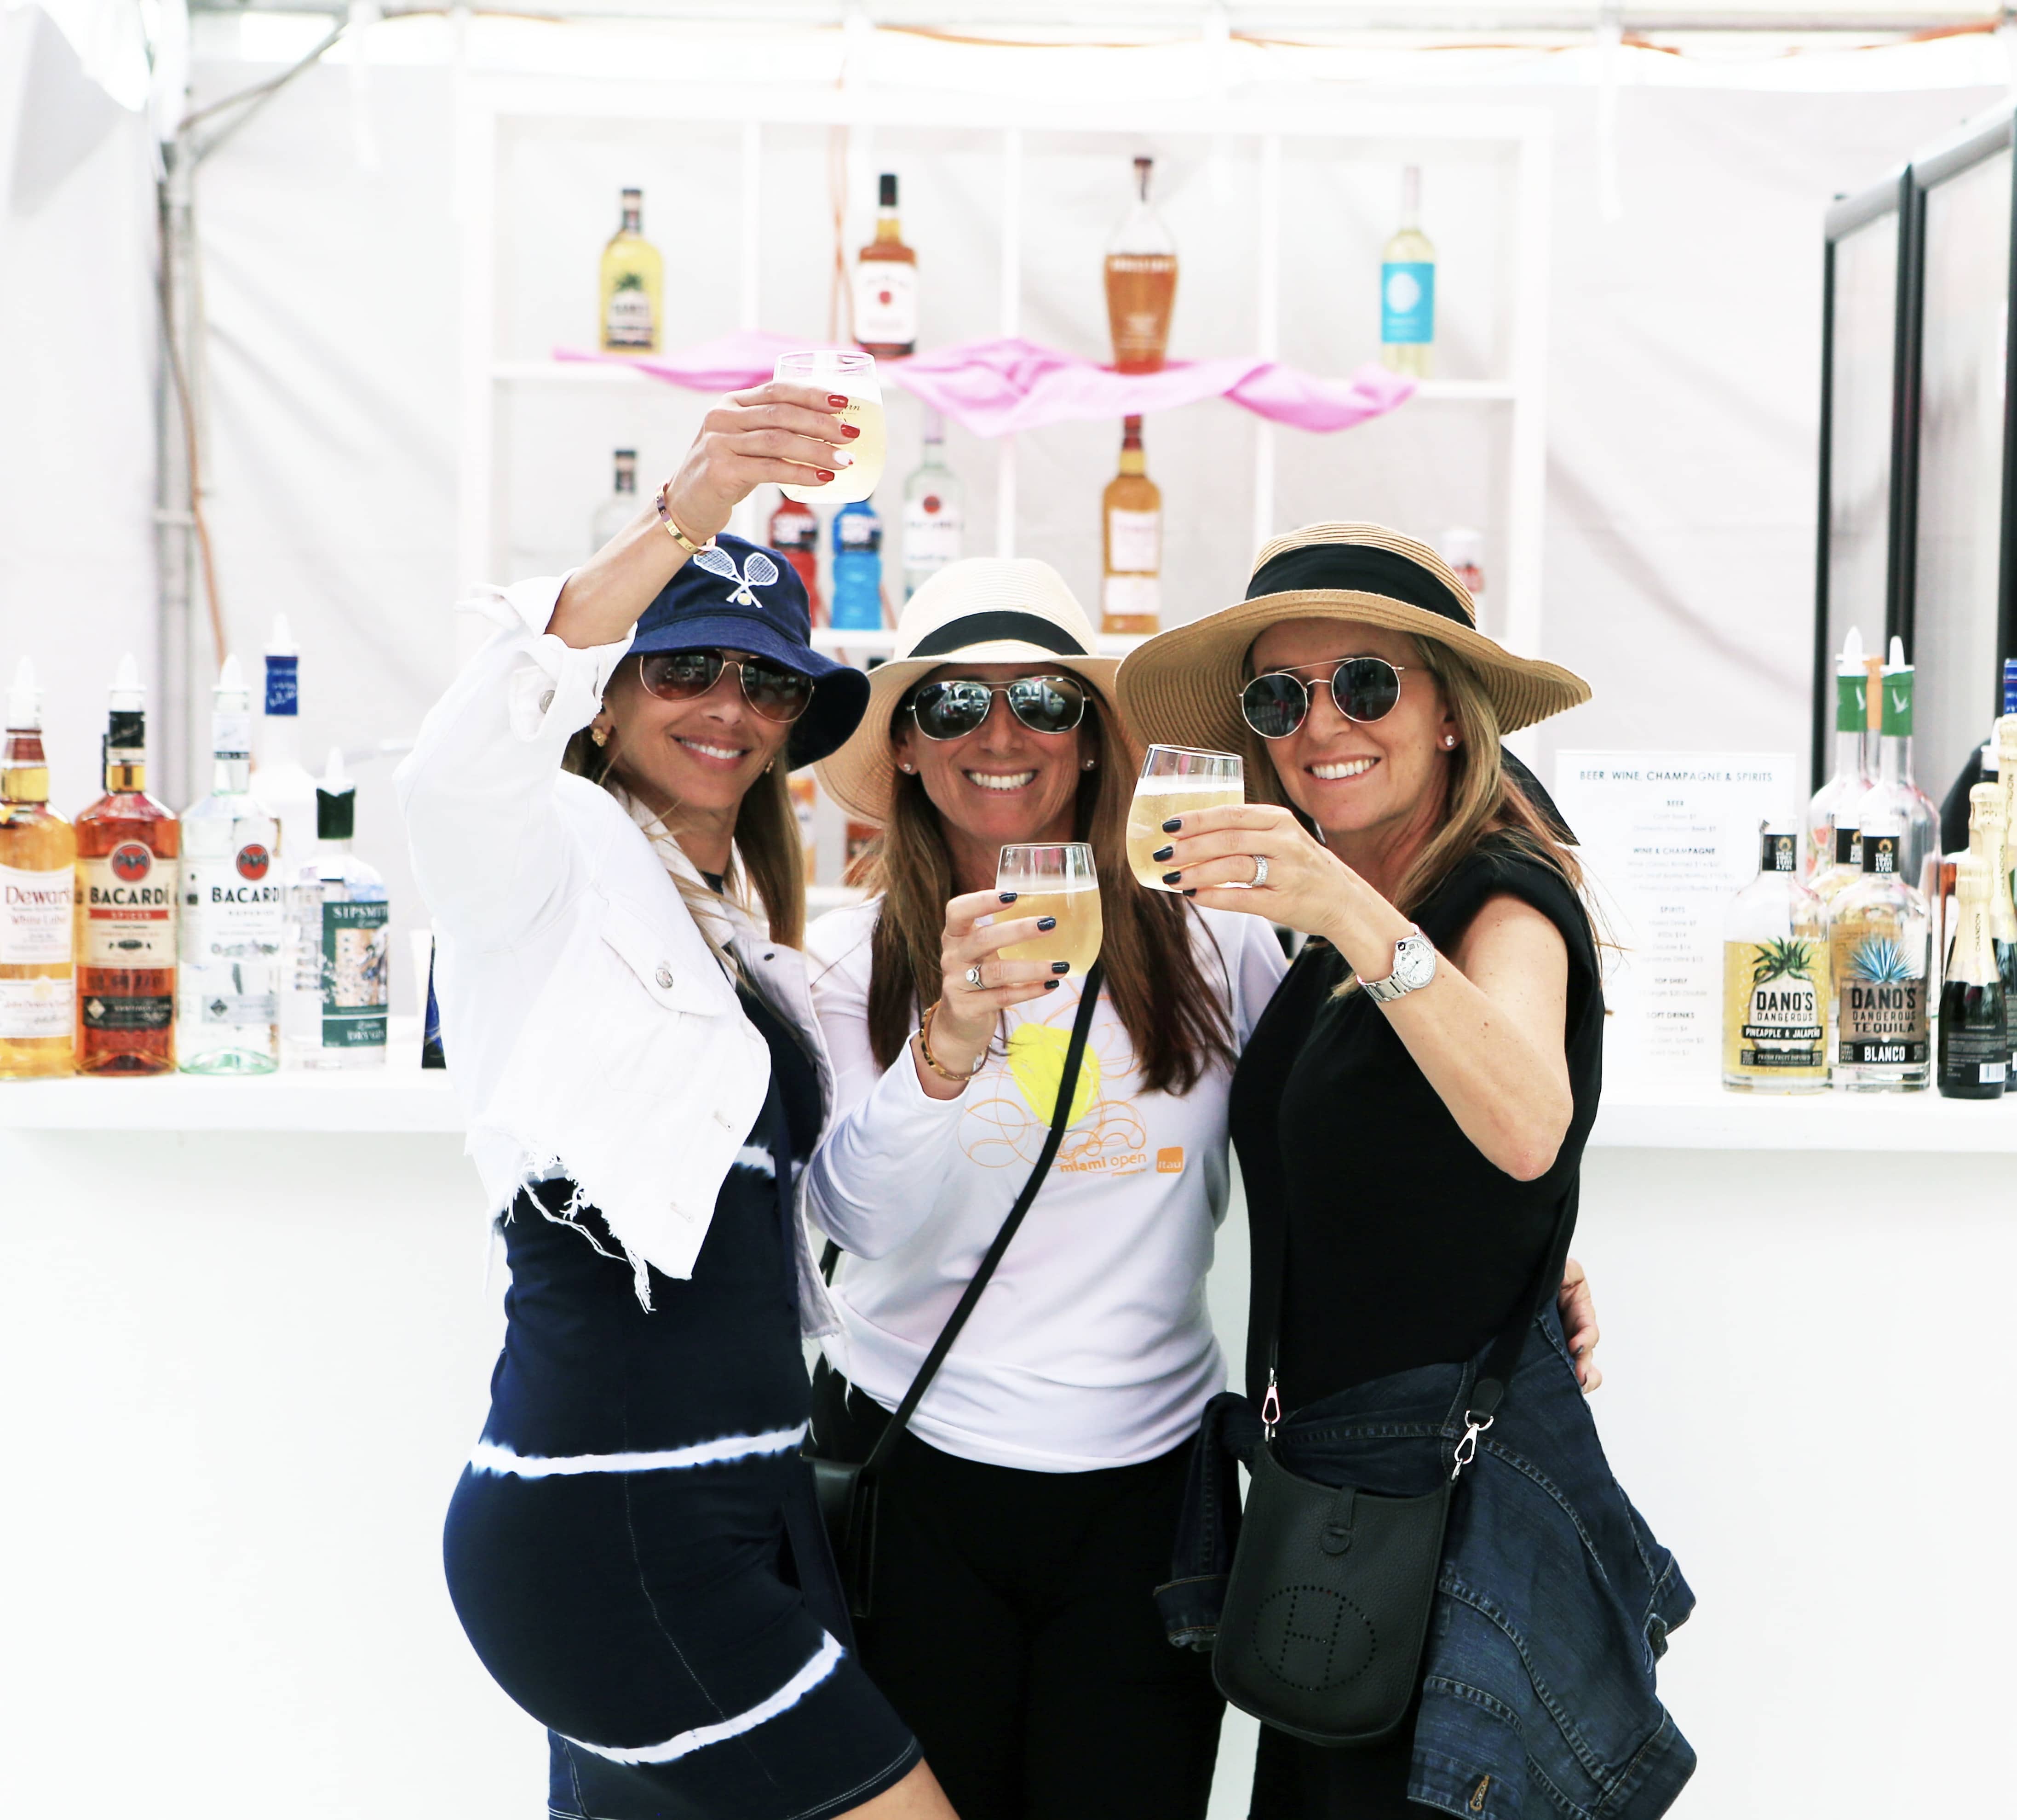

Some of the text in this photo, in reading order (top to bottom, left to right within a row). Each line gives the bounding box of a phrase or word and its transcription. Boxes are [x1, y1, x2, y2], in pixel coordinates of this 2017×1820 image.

[1646, 771, 1721, 781] CHAMPAGNE
[1725, 772, 1732, 781] &
[1736, 772, 1773, 781] SPIRITS
[90, 883, 170, 904] BACARDÍ
[1757, 991, 1813, 1010] DANO'S
[1852, 987, 1916, 1009] DANO'S
[1758, 1012, 1813, 1022] DANGEROUS
[1853, 1010, 1915, 1021] DANGEROUS
[1746, 1027, 1781, 1038] PINEAPPLE
[1785, 1029, 1789, 1038] &
[1853, 1022, 1915, 1033] TEQUILA
[1864, 1045, 1906, 1062] BLANCO
[1060, 1153, 1147, 1172] miami open
